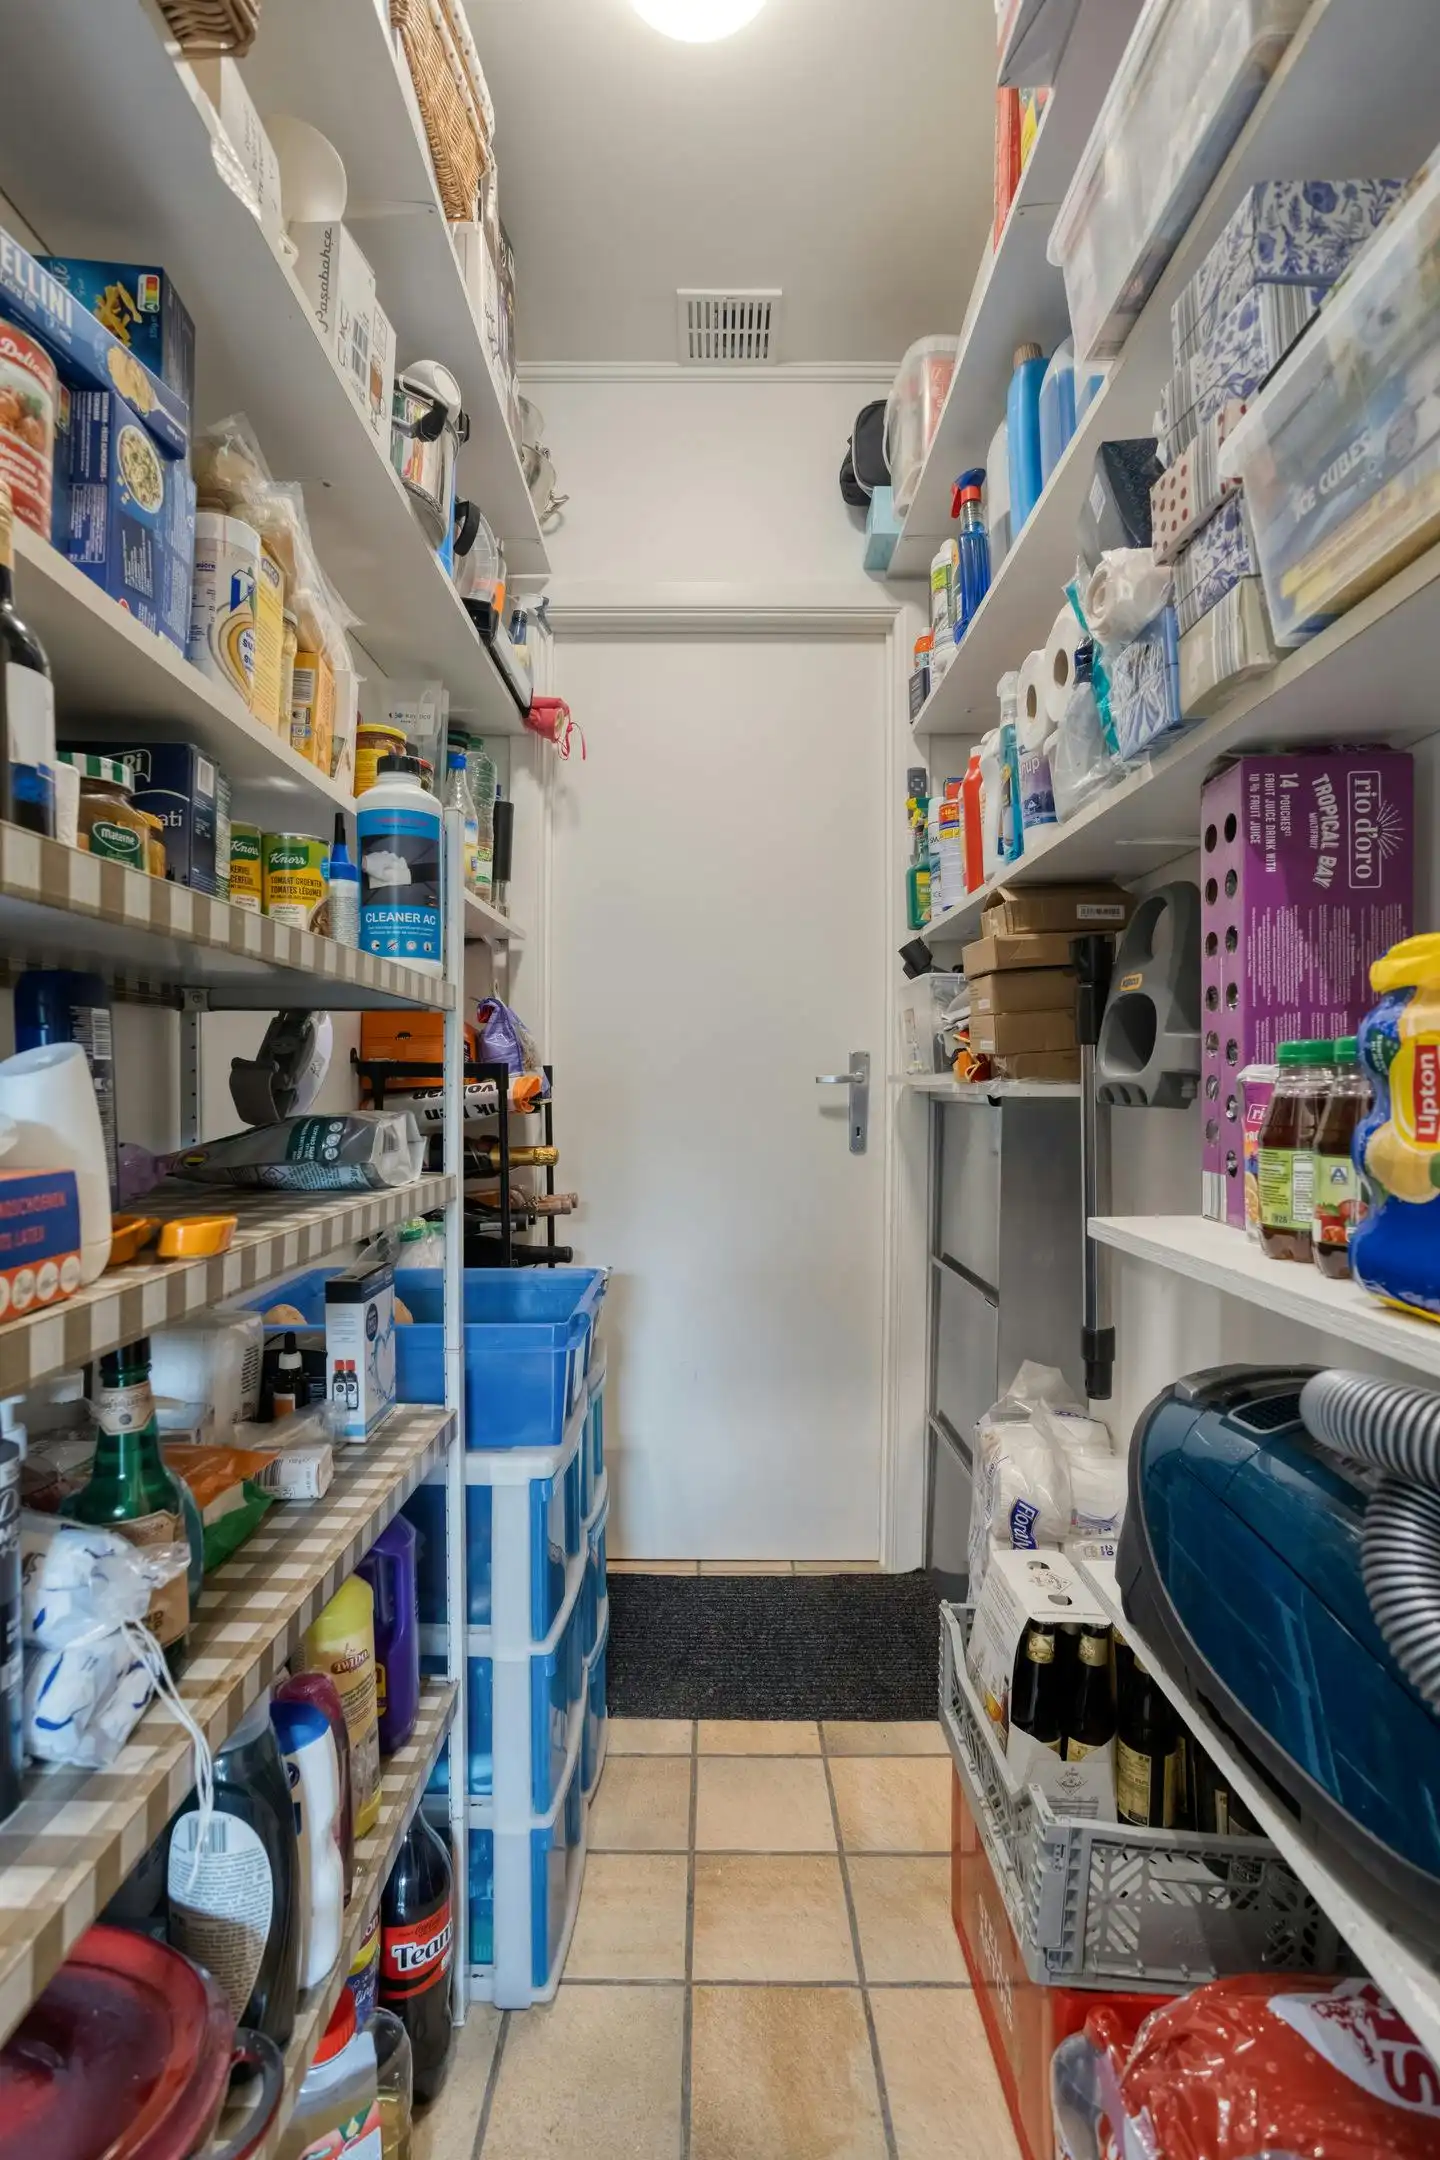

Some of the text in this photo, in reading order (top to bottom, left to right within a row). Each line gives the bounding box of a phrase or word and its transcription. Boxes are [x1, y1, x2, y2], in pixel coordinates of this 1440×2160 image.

[1318, 430, 1372, 495] CUBES
[1249, 773, 1260, 782] 10
[1279, 773, 1299, 789] 14
[1249, 794, 1260, 818] FRUIT
[1250, 820, 1261, 844] JUICE
[1264, 773, 1276, 873] FRUIT JUICE DRINK WITH
[1309, 812, 1319, 849] MULTIFRUIT
[1312, 773, 1340, 889] TROPICAL BAY
[1354, 778, 1379, 879] rio d'oro
[269, 852, 307, 866] Knorr
[270, 886, 298, 895] TOMATES
[365, 911, 436, 926] CLEANER AC
[1418, 1051, 1436, 1136] Lipton
